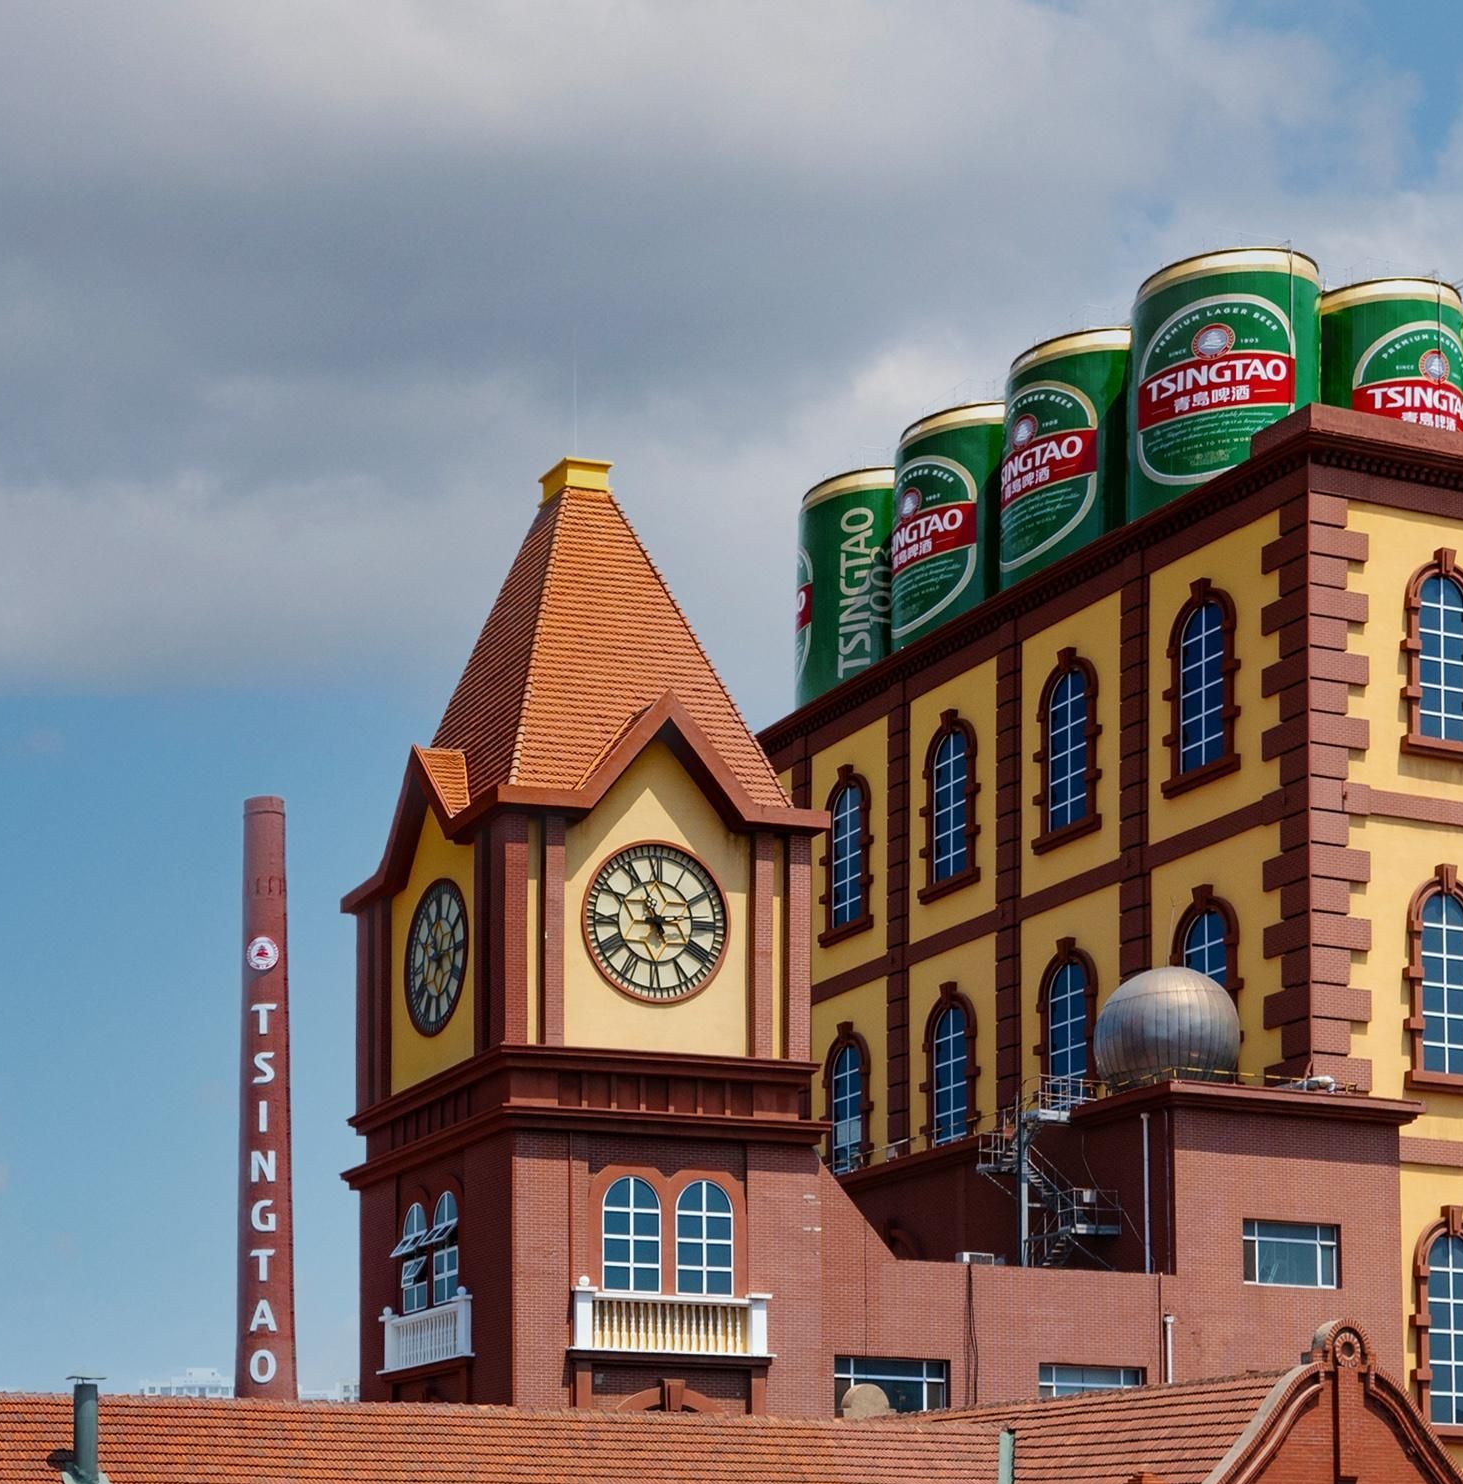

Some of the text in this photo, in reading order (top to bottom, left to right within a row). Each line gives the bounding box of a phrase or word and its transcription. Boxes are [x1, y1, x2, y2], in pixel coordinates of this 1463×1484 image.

[1155, 308, 1278, 353] PREMIUM LAGER BEER
[1381, 334, 1429, 359] PREMIUM
[1049, 395, 1073, 409] BEER
[1146, 358, 1287, 403] TSINGTAO
[837, 506, 875, 680] TSINGTAO
[249, 1002, 278, 1384] TSINGTAO
